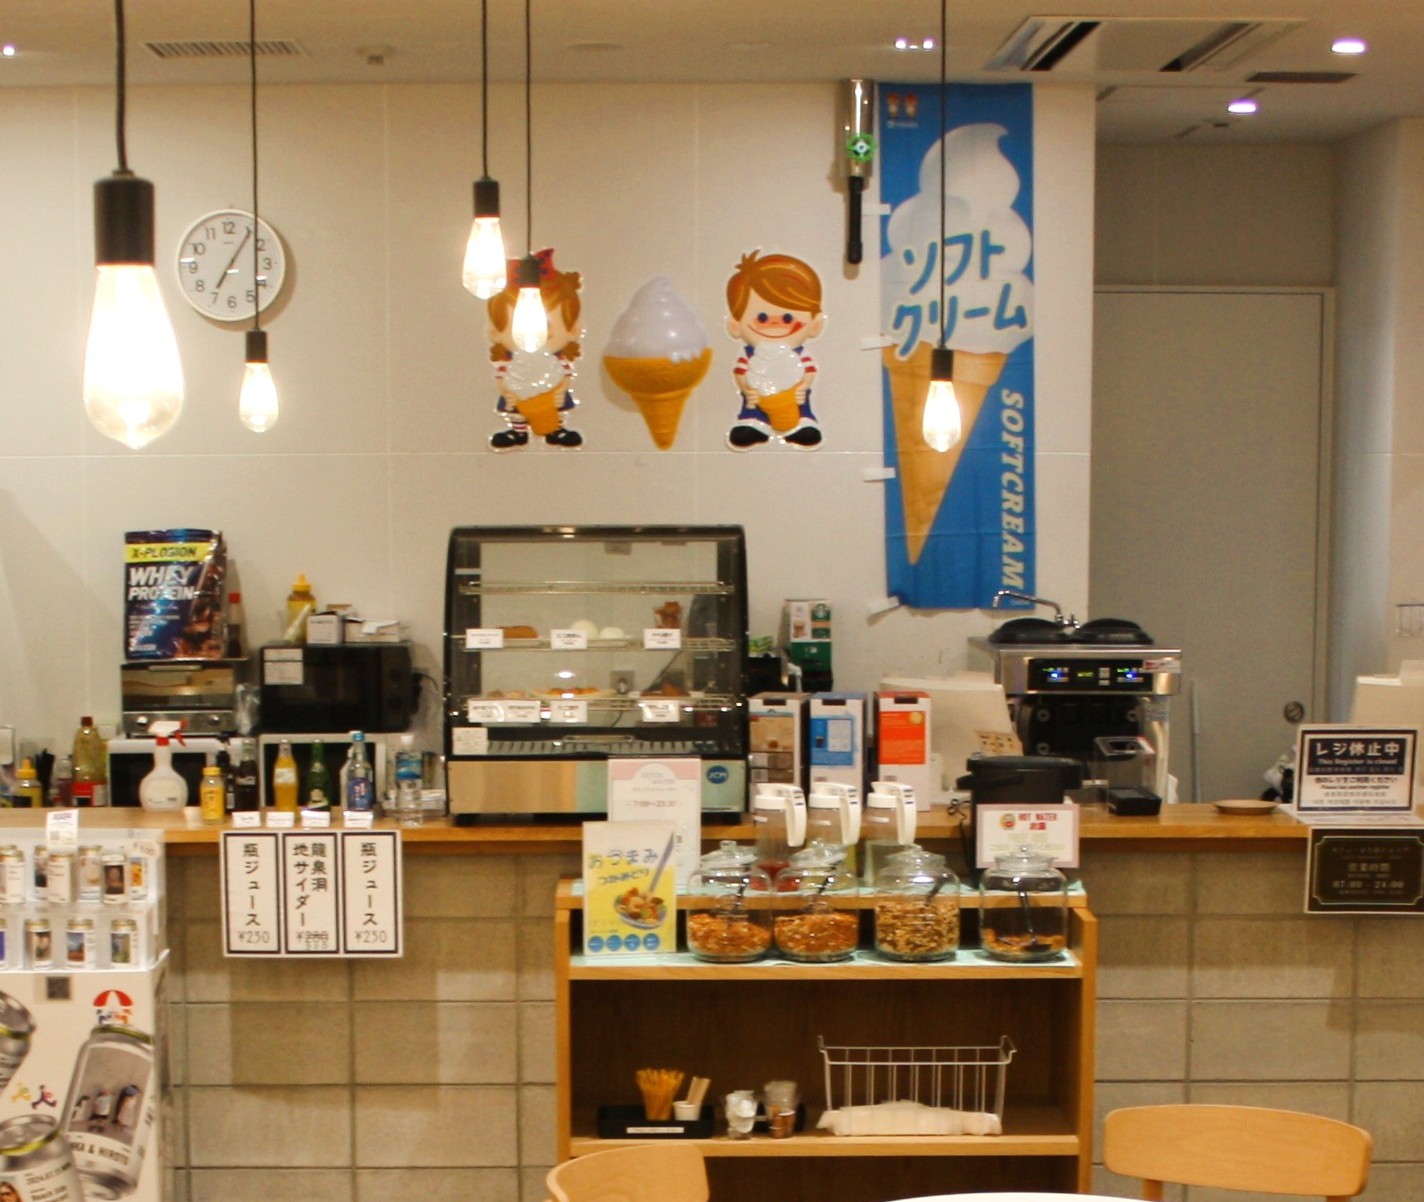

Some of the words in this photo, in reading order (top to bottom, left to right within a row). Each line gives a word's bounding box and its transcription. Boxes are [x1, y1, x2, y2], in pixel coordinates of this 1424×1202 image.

[206, 227, 216, 240] 11
[222, 221, 236, 235] 12
[192, 242, 206, 255] 10
[263, 257, 272, 270] 3
[903, 229, 1005, 295] ソフト
[195, 279, 205, 293] 8
[210, 291, 219, 304] 7
[227, 296, 237, 309] 6
[246, 289, 256, 303] 5
[893, 282, 1028, 357] クリーム
[1001, 388, 1025, 587] SOFTCREAM
[131, 546, 197, 559] X-PLOSION
[128, 565, 196, 587] WHEY
[127, 586, 196, 601] PROTEIN
[1316, 742, 1400, 757] レジ休止中
[588, 847, 659, 869] おつまみ
[310, 842, 328, 893] 龍泉洞
[242, 842, 262, 927] 瓶ジュース
[292, 842, 310, 927] 地サイダー
[360, 842, 378, 927] 瓶ジュース
[237, 930, 271, 944] ¥250
[354, 930, 388, 944] ¥250
